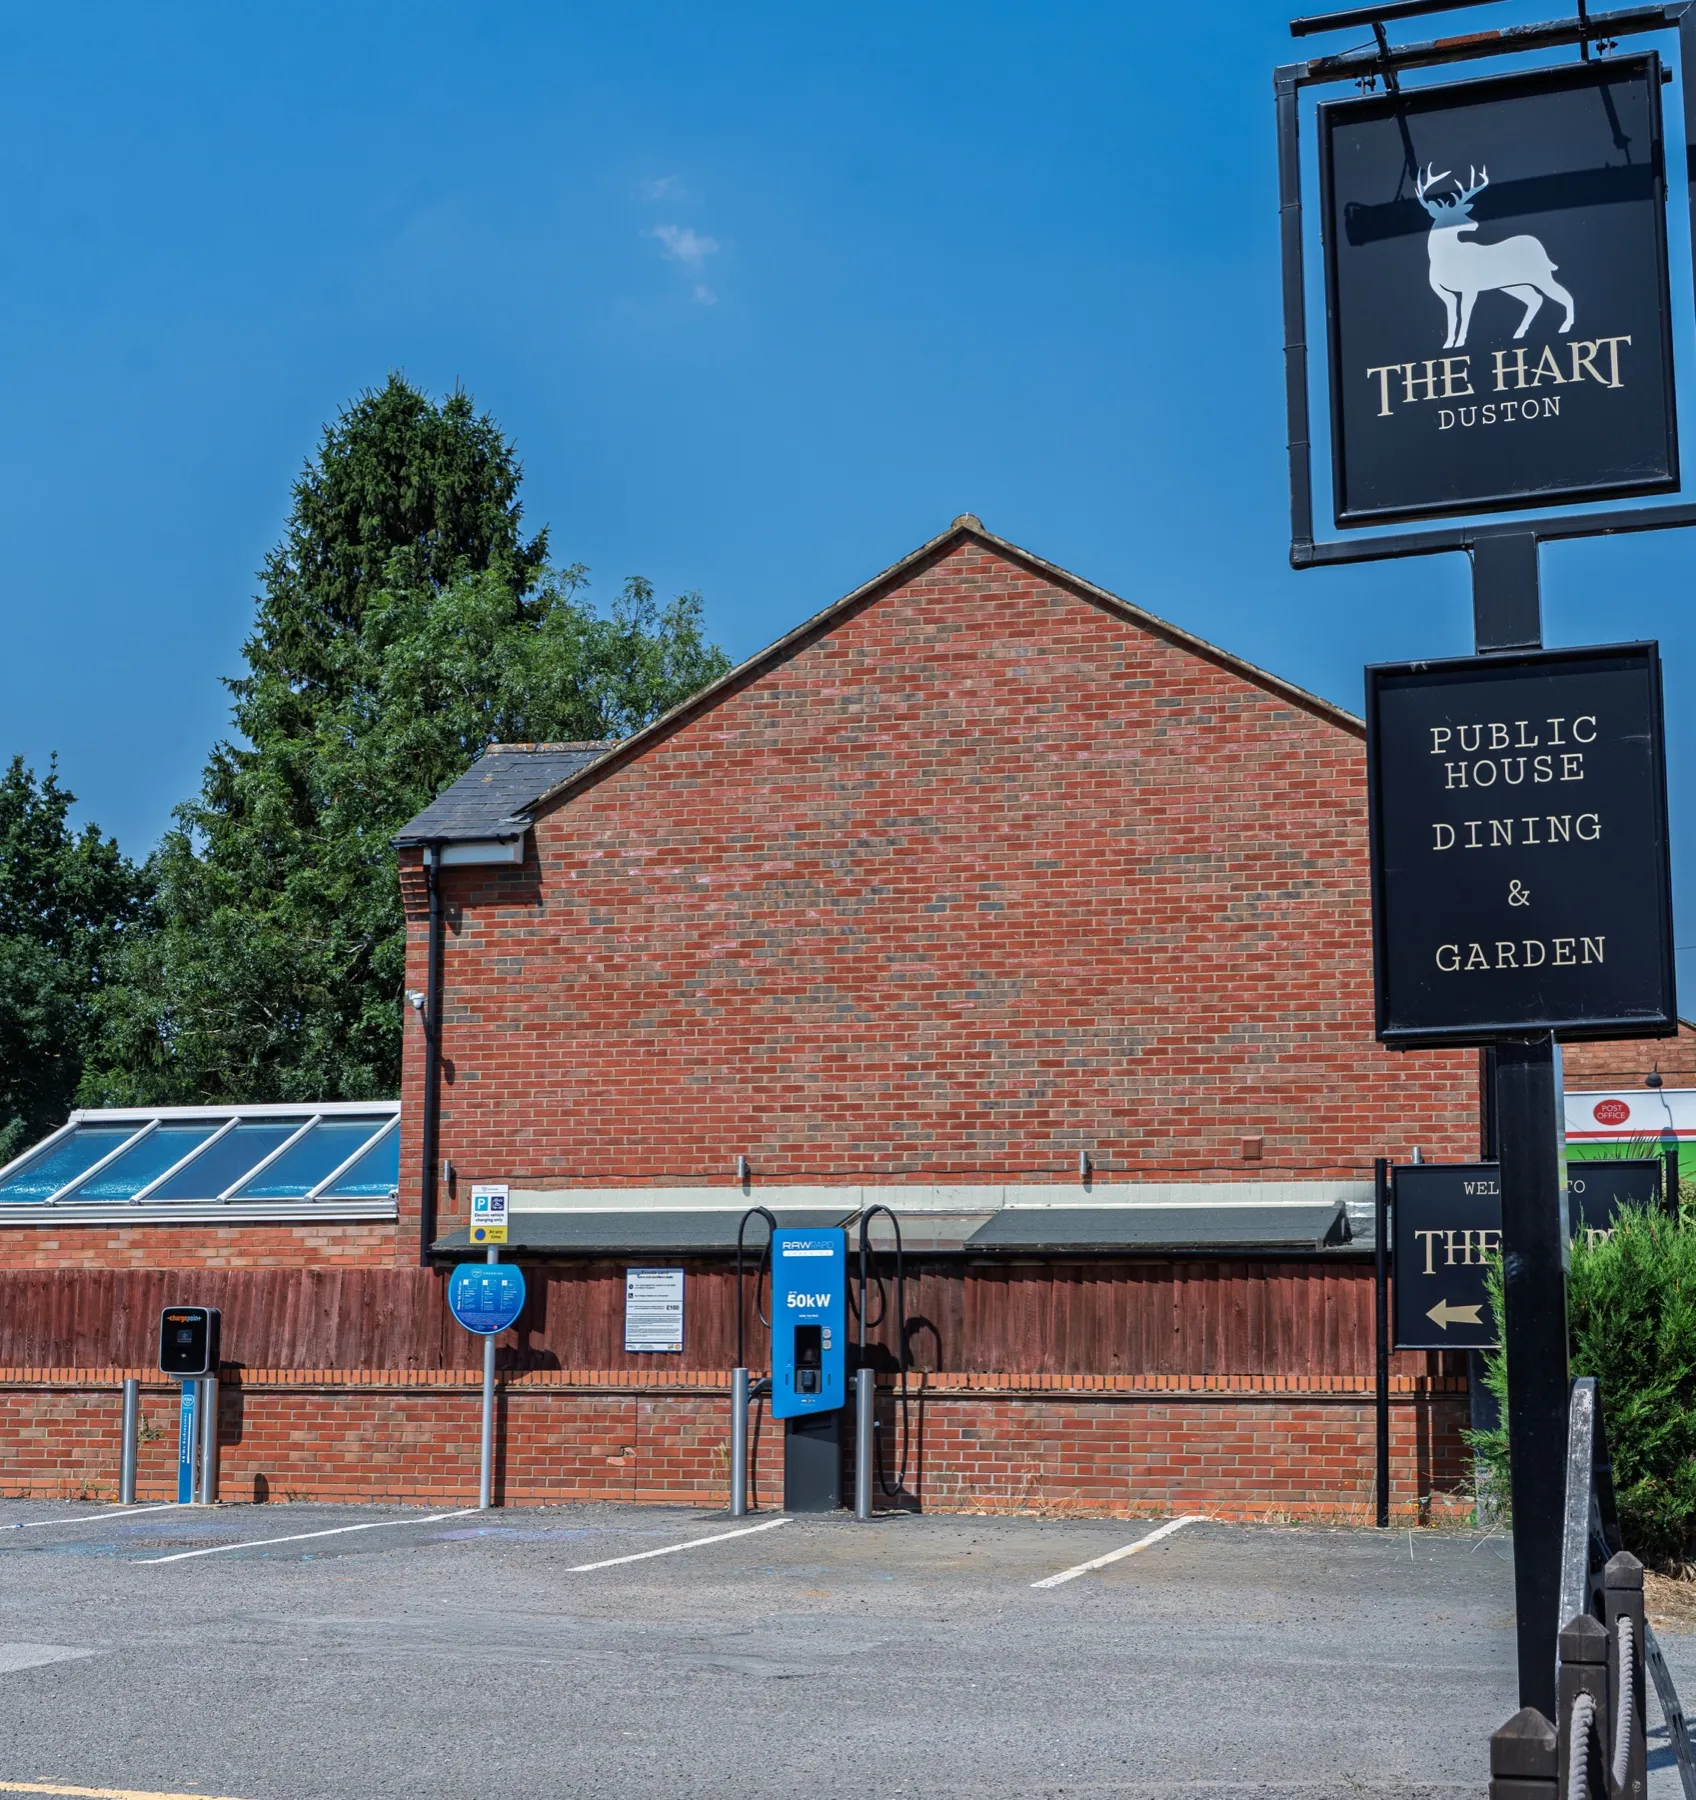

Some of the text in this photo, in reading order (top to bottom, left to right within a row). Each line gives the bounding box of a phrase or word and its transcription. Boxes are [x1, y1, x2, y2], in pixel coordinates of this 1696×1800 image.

[1366, 335, 1632, 417] THE HART
[1437, 396, 1561, 430] DUSTON
[1430, 716, 1597, 754] PUBLIC
[1444, 753, 1584, 789] HOUSE
[1432, 813, 1602, 850] DINING
[1508, 879, 1530, 907] &
[1435, 936, 1606, 972] GARDEN
[1597, 1111, 1626, 1119] OFFICE
[1601, 1104, 1622, 1112] POST
[477, 1198, 486, 1209] P
[1414, 1229, 1503, 1274] THE
[787, 1294, 832, 1308] 50kW
